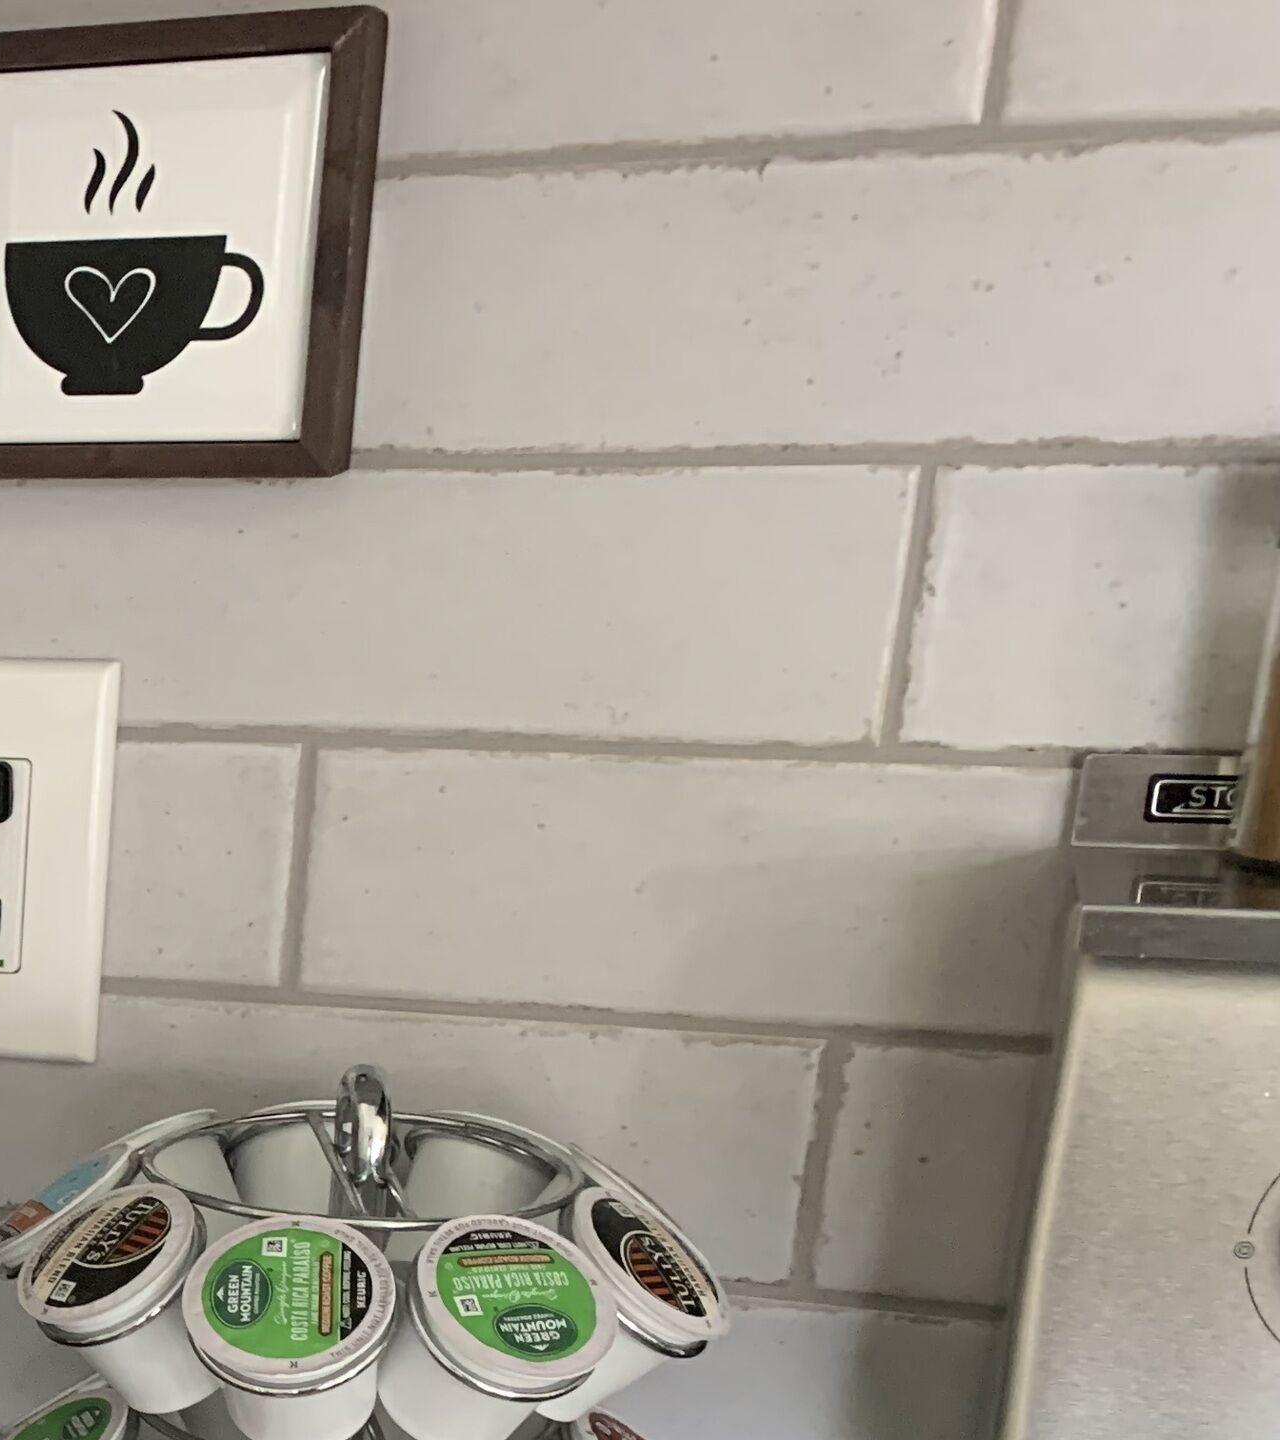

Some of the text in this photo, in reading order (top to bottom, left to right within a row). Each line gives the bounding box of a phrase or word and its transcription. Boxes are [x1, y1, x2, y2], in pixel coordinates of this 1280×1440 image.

[85, 1197, 158, 1264] TULLY'S
[469, 1231, 511, 1241] KEURIG
[502, 1272, 532, 1287] RICA
[533, 1271, 569, 1286] COSTA
[642, 1236, 694, 1312] TULLY'S
[227, 1275, 238, 1313] GREEN
[240, 1265, 252, 1321] MOUNTAIN
[293, 1286, 310, 1307] RICA
[357, 1271, 366, 1308] KEURIG
[291, 1309, 309, 1340] COSTA
[499, 1317, 567, 1332] MOUNTAIN
[513, 1329, 561, 1343] GREEN
